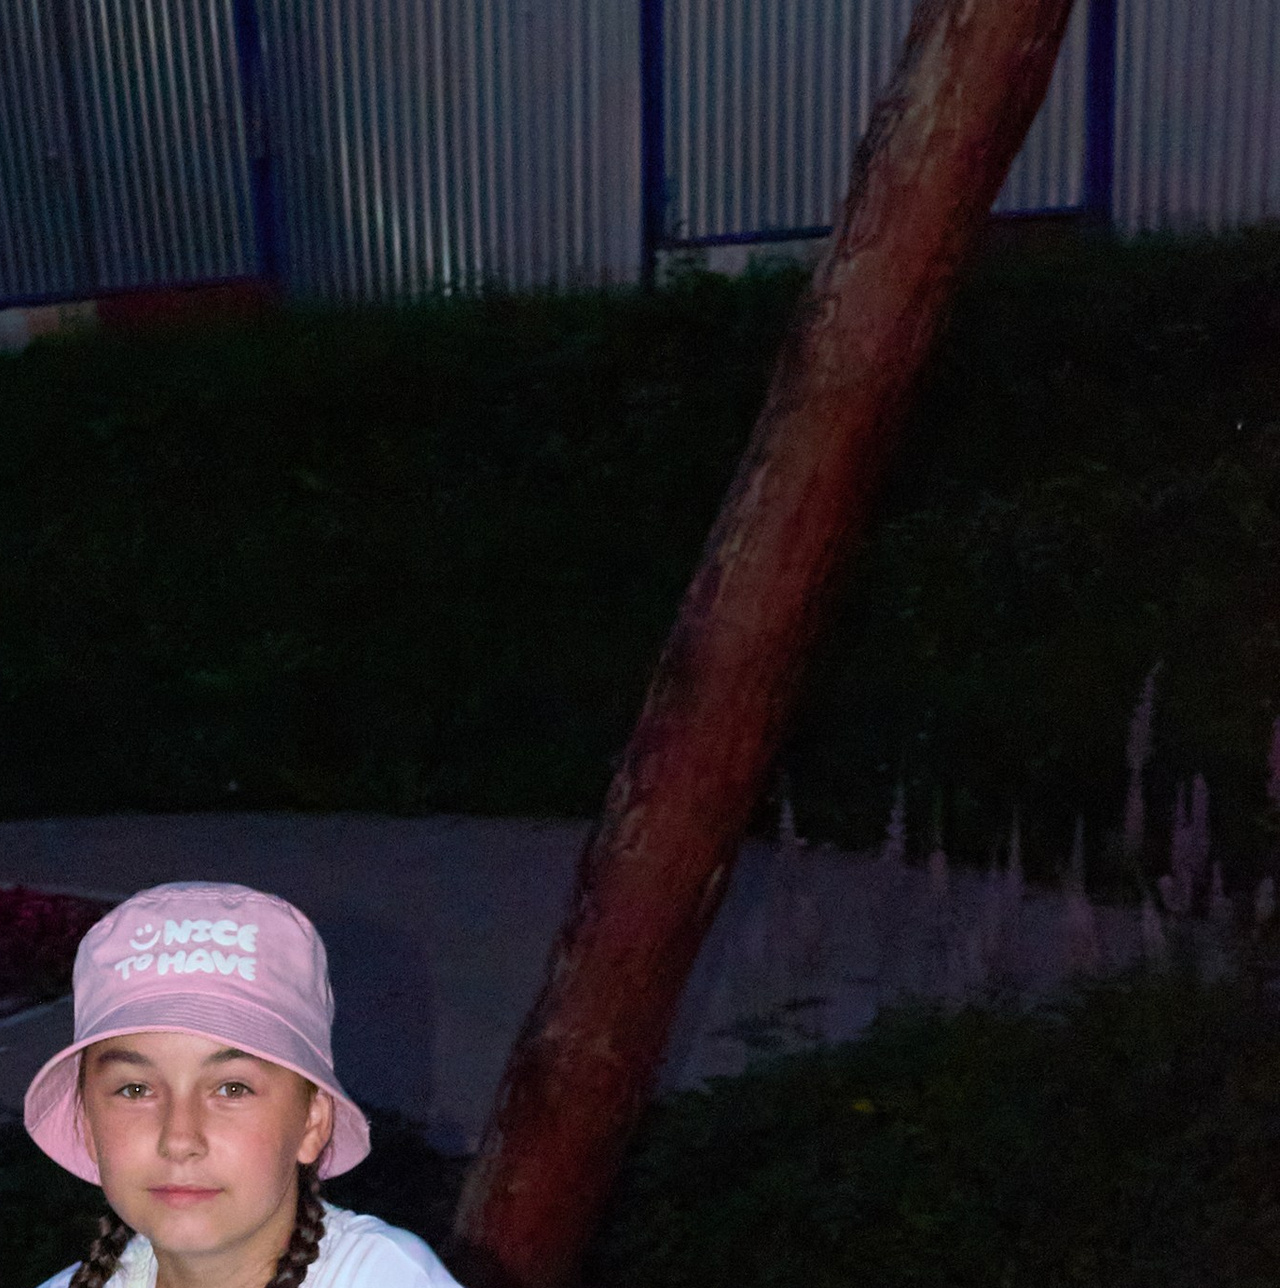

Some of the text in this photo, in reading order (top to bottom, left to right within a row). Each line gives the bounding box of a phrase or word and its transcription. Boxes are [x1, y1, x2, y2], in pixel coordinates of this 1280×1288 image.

[163, 919, 259, 952] NICE
[114, 948, 257, 981] TO HAVE
